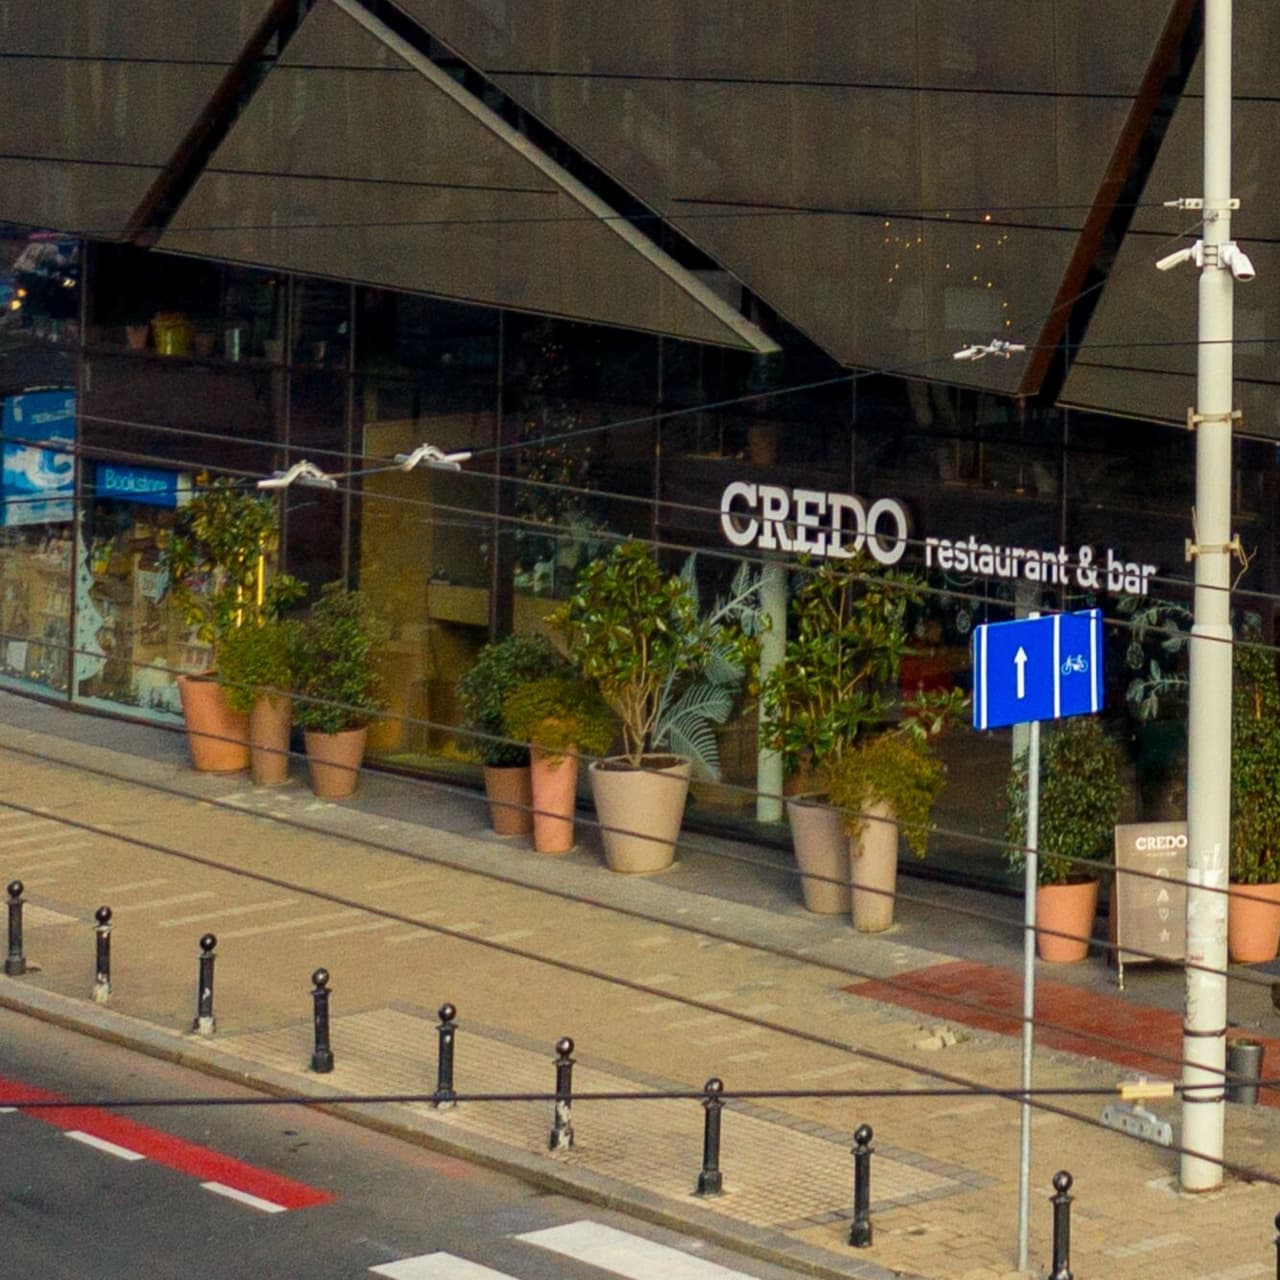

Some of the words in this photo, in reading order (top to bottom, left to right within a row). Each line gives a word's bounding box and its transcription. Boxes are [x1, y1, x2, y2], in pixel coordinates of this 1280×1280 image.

[104, 468, 168, 493] Bookstore
[720, 481, 909, 566] CREDO
[925, 534, 1068, 586] restaurant
[1077, 544, 1099, 590] &
[1107, 550, 1157, 596] bar
[1135, 834, 1188, 851] CREDO
